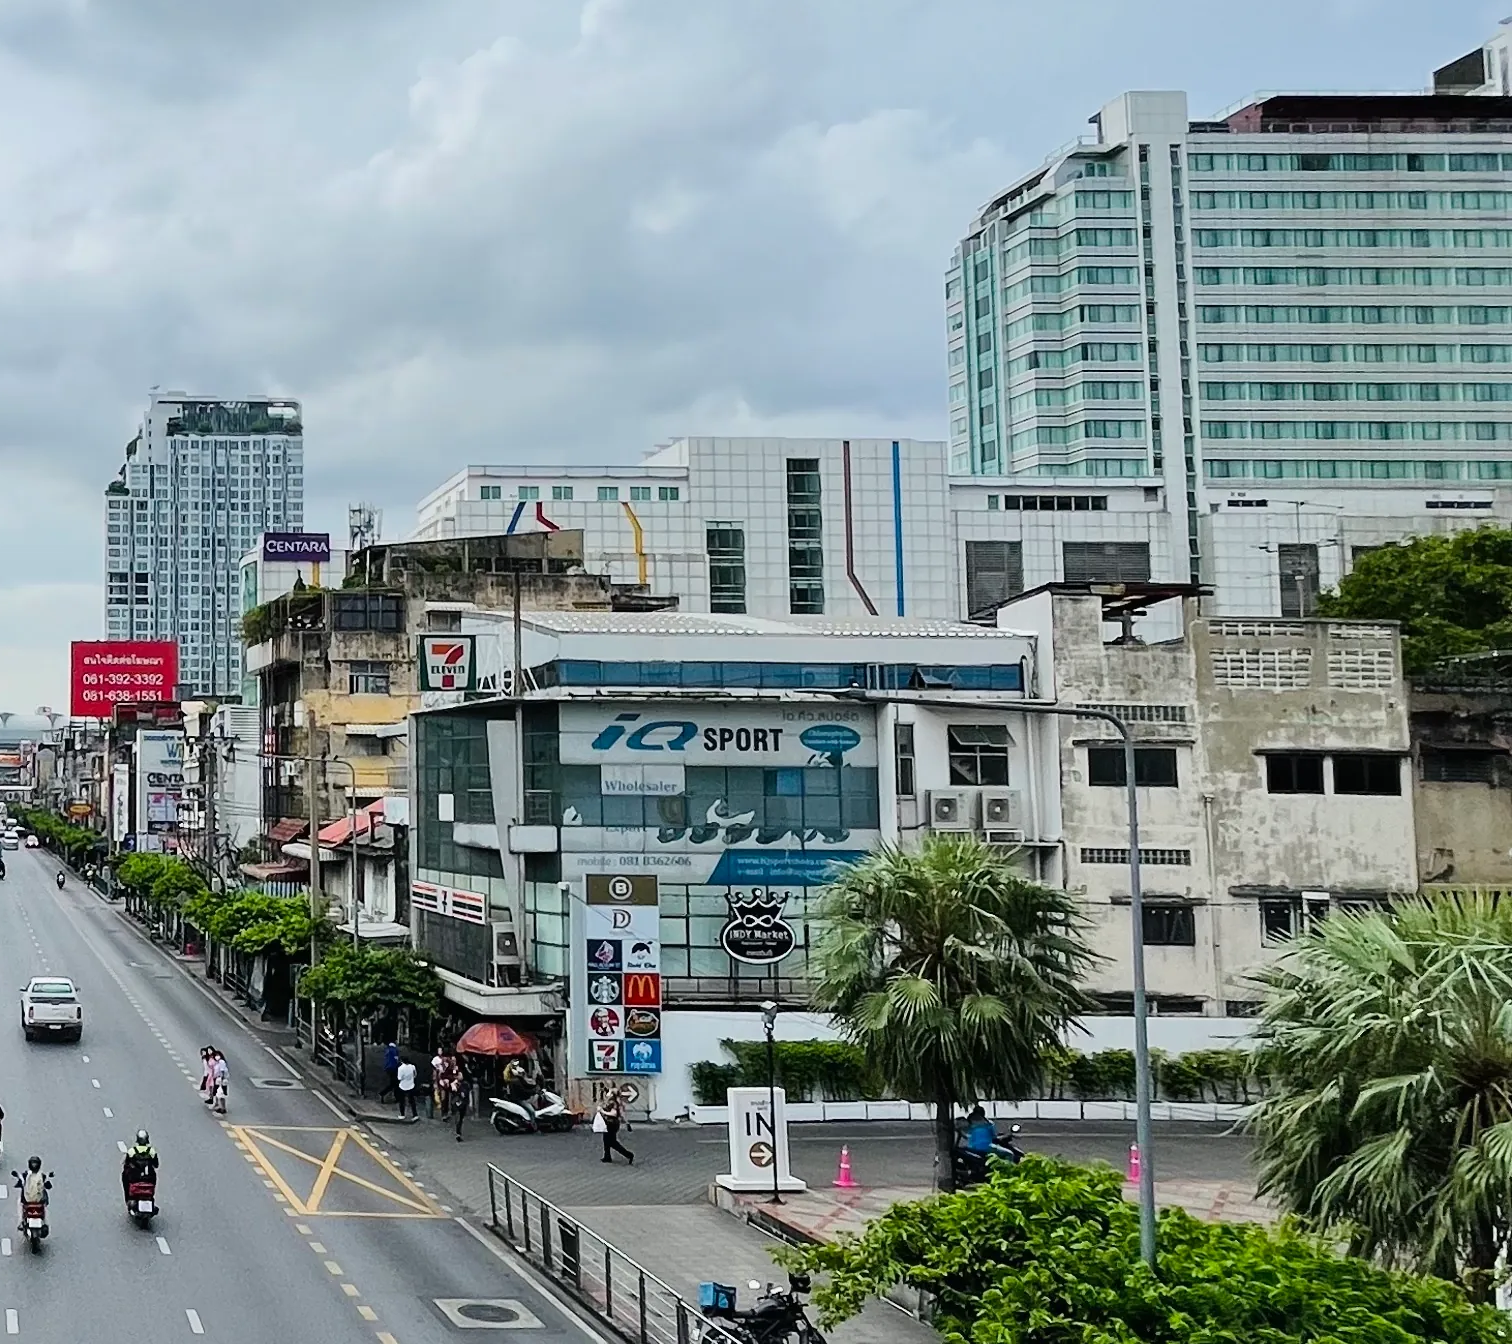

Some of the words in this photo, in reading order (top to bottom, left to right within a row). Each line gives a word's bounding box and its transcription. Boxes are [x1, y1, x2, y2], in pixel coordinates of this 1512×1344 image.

[266, 540, 329, 553] CENTARA
[703, 727, 784, 752] SPORT
[604, 780, 678, 793] Wholesaler
[619, 856, 639, 867] 081
[745, 1112, 775, 1136] IN
